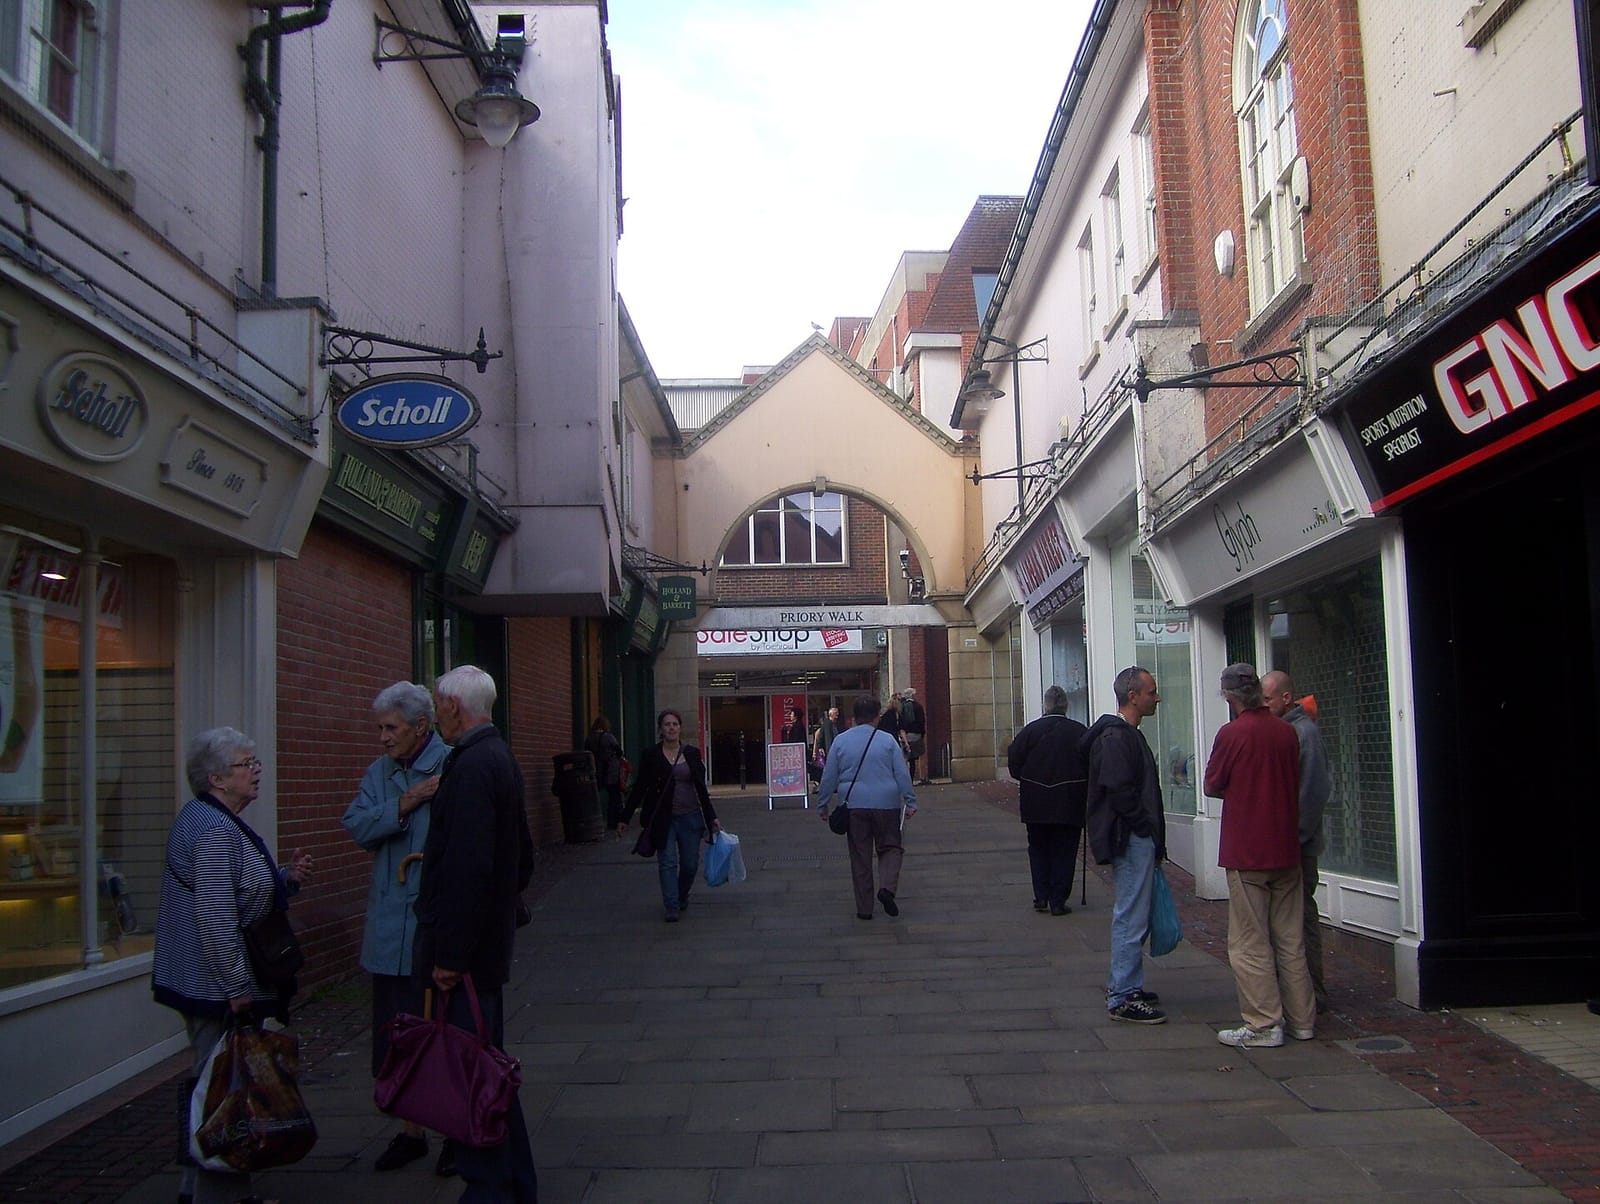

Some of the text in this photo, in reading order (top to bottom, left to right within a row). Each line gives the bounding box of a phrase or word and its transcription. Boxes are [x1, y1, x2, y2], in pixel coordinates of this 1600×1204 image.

[49, 369, 138, 438] Scholl
[358, 396, 453, 427] Scholl
[1361, 394, 1427, 446] SPORTS NUTRITION
[1383, 427, 1422, 461] SPECIALIST
[336, 453, 384, 501] HOLLAND
[1213, 501, 1262, 572] Glyph
[662, 587, 692, 596] HOLLAND
[662, 601, 692, 610] BARRETT
[780, 611, 864, 622] PRIORY WALK
[772, 759, 801, 770] DEALS
